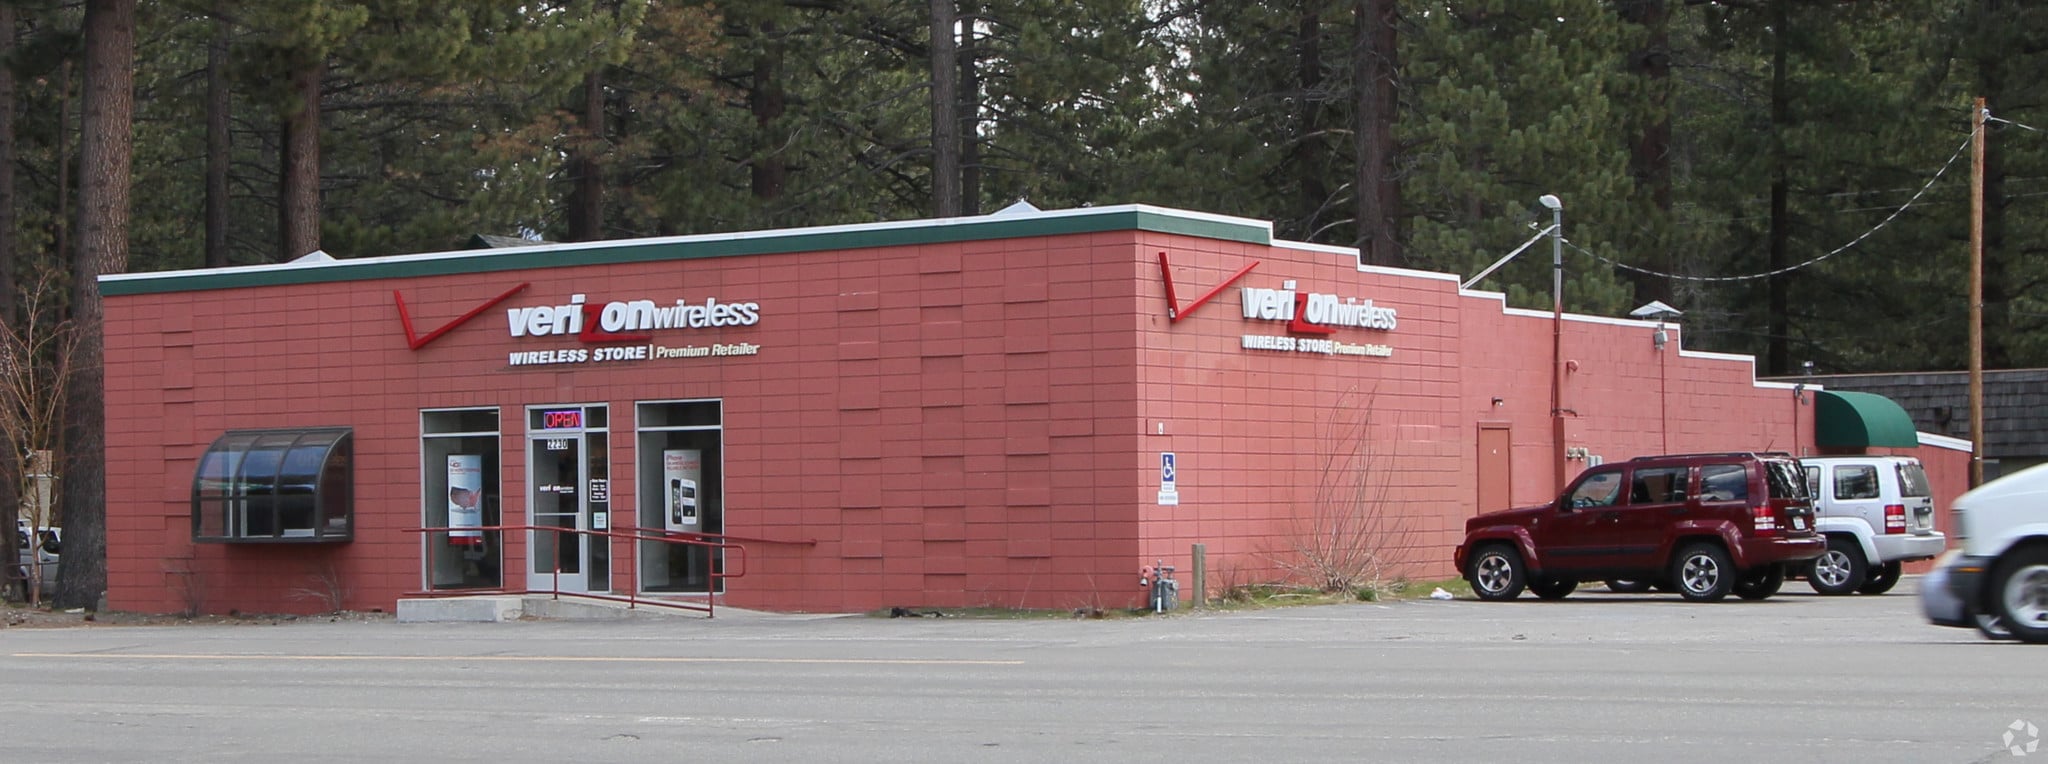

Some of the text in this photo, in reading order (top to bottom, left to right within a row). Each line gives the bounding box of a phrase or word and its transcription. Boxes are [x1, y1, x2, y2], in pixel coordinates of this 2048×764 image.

[1242, 334, 1296, 350] WIRELESS
[1298, 338, 1331, 354] STORE
[509, 343, 760, 365] WIRELESS STORE Premium Retailer
[546, 413, 580, 428] OPEN
[547, 439, 568, 449] 2230
